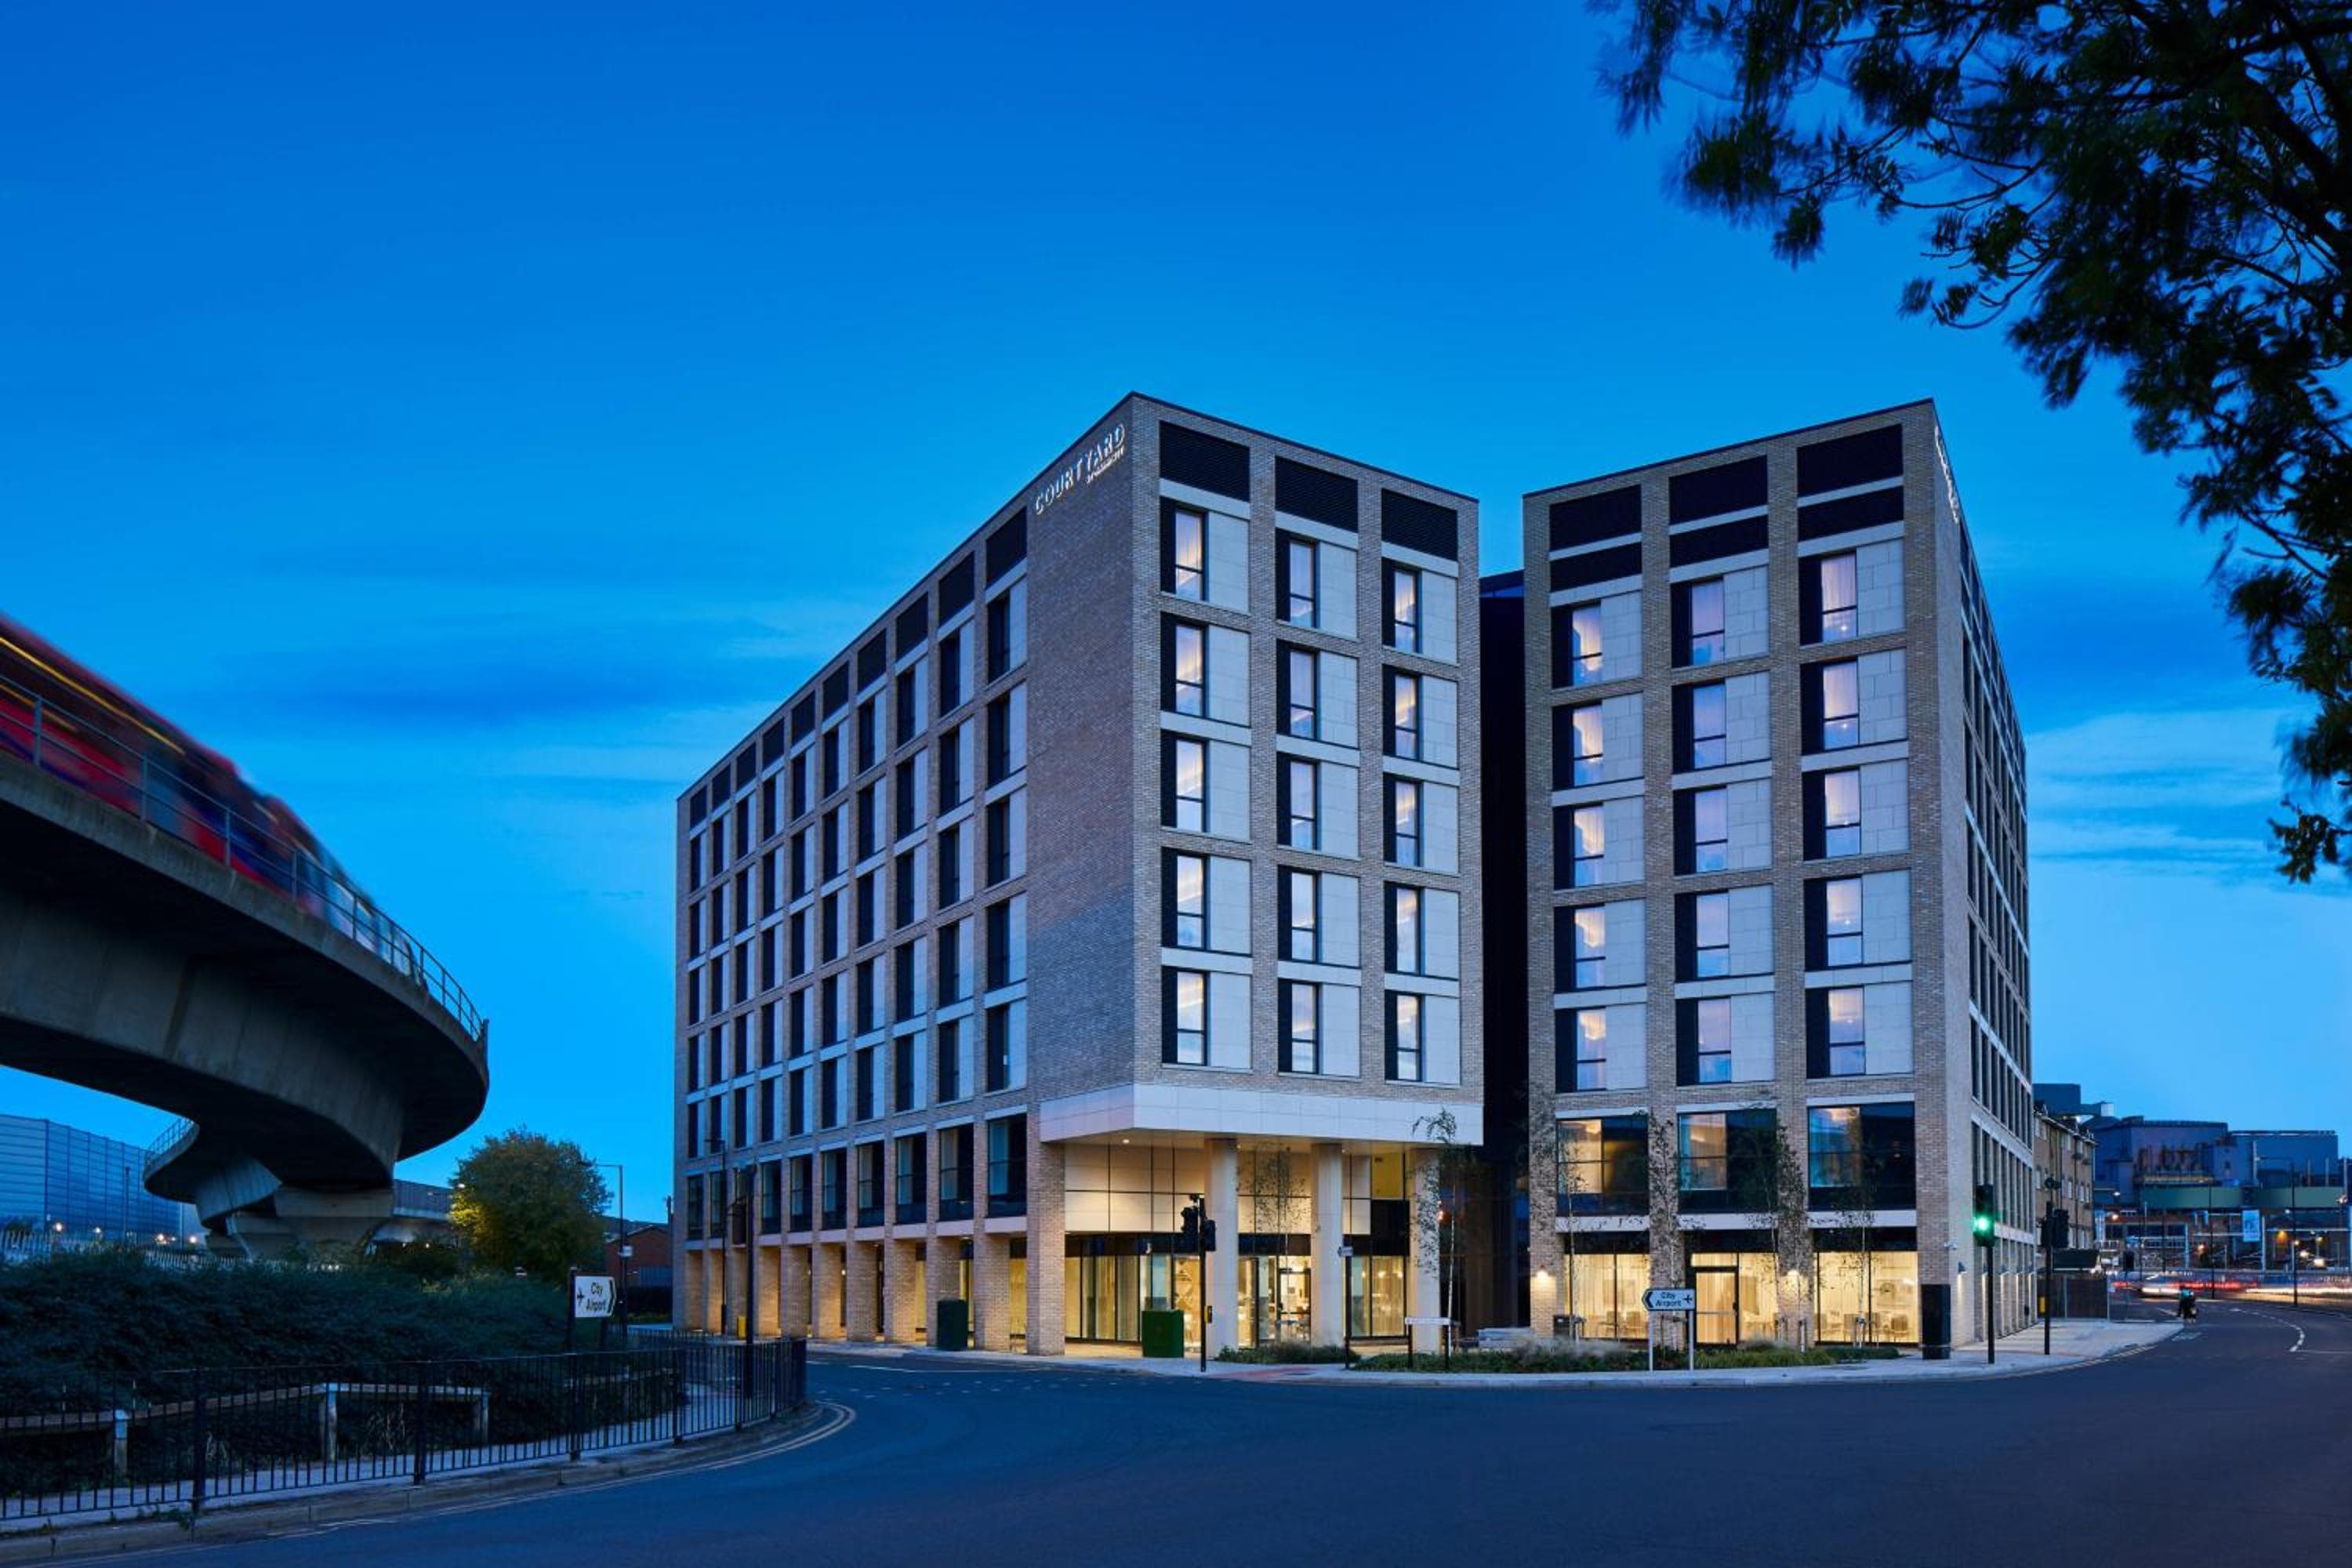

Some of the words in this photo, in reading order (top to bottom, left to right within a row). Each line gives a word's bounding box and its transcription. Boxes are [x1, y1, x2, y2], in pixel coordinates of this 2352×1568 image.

[1036, 423, 1125, 515] COURTYARD
[590, 1282, 603, 1297] City
[1660, 1291, 1675, 1300] City
[586, 1298, 607, 1312] Airport
